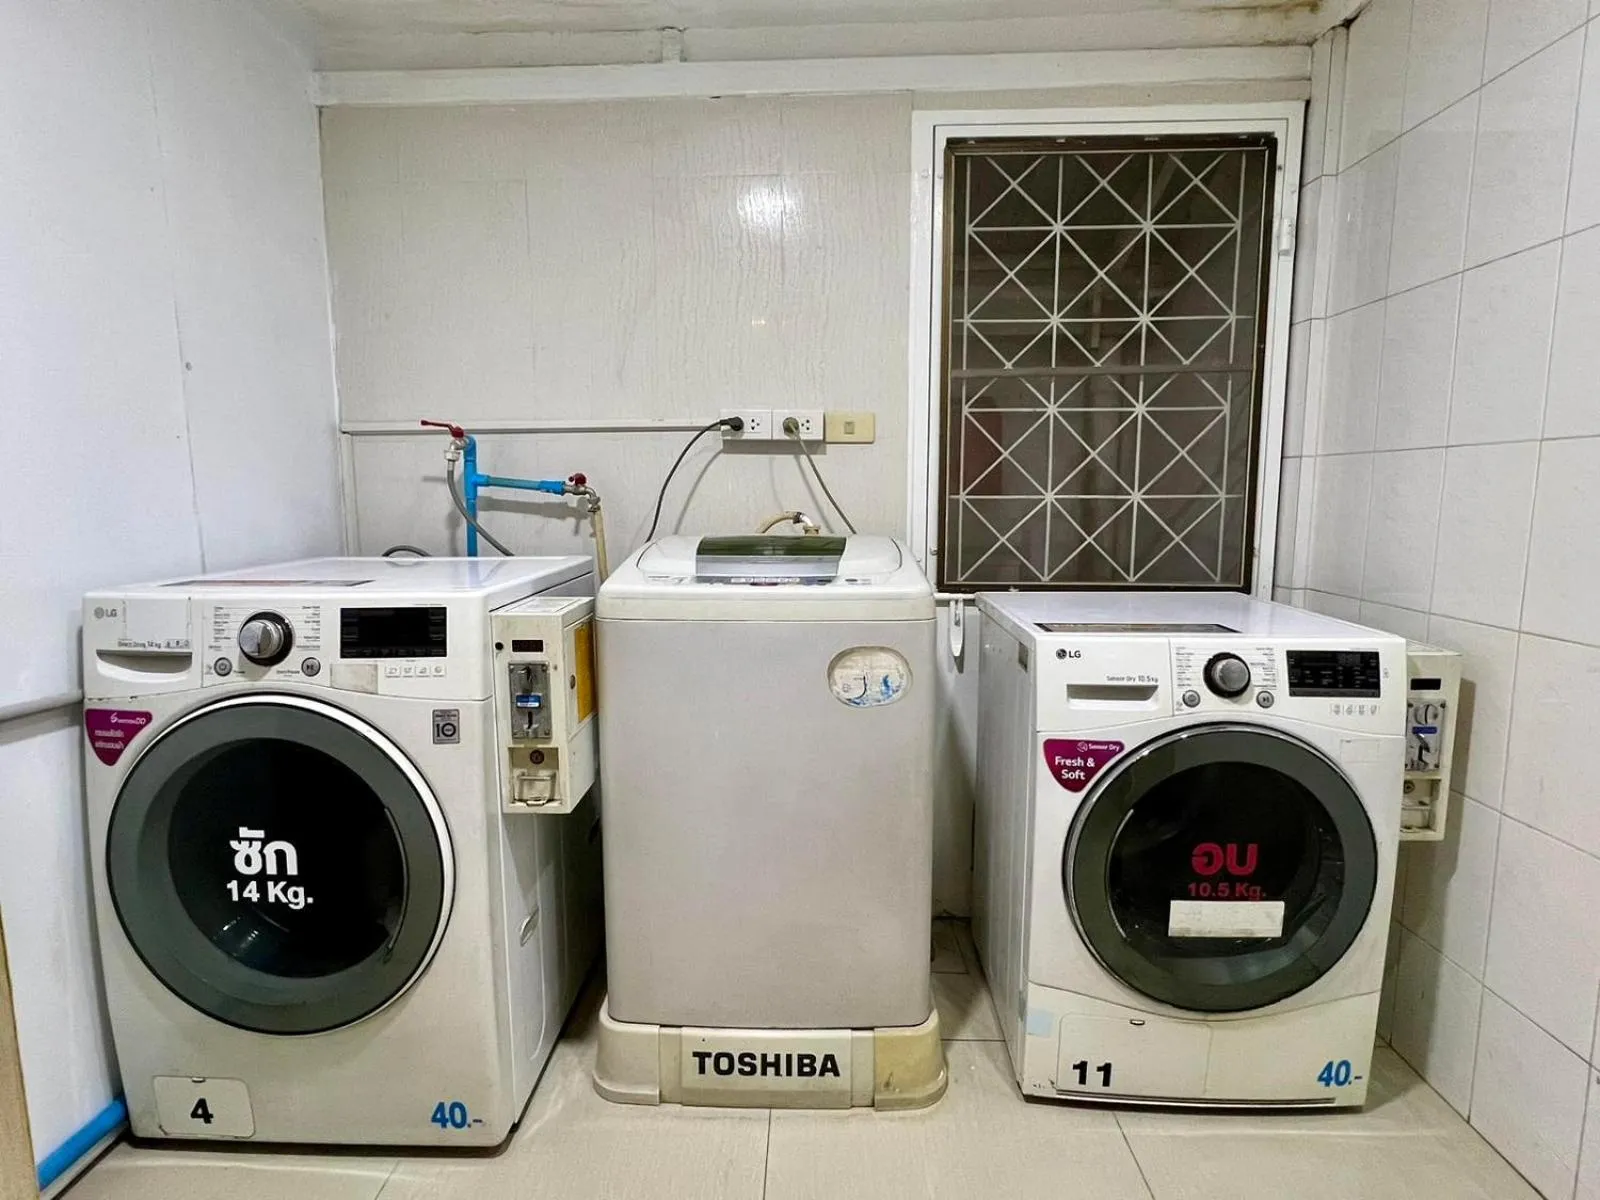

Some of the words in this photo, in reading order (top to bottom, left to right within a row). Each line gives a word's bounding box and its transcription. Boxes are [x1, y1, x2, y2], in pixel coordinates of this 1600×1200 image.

[1054, 755, 1084, 767] Fresh
[1086, 757, 1095, 767] &
[1109, 744, 1120, 752] Dry
[1061, 769, 1085, 780] Soft
[229, 826, 298, 875] ซัก
[1191, 842, 1258, 876] อบ
[226, 880, 260, 902] 14
[267, 881, 313, 910] Kg.
[1188, 882, 1230, 897] 10.5
[1235, 882, 1267, 901] Kg.
[692, 1051, 840, 1077] TOSHIBA
[1072, 1060, 1112, 1087] 11
[1317, 1060, 1363, 1087] 40.-
[190, 1098, 214, 1124] 4
[431, 1101, 483, 1129] 40.-
